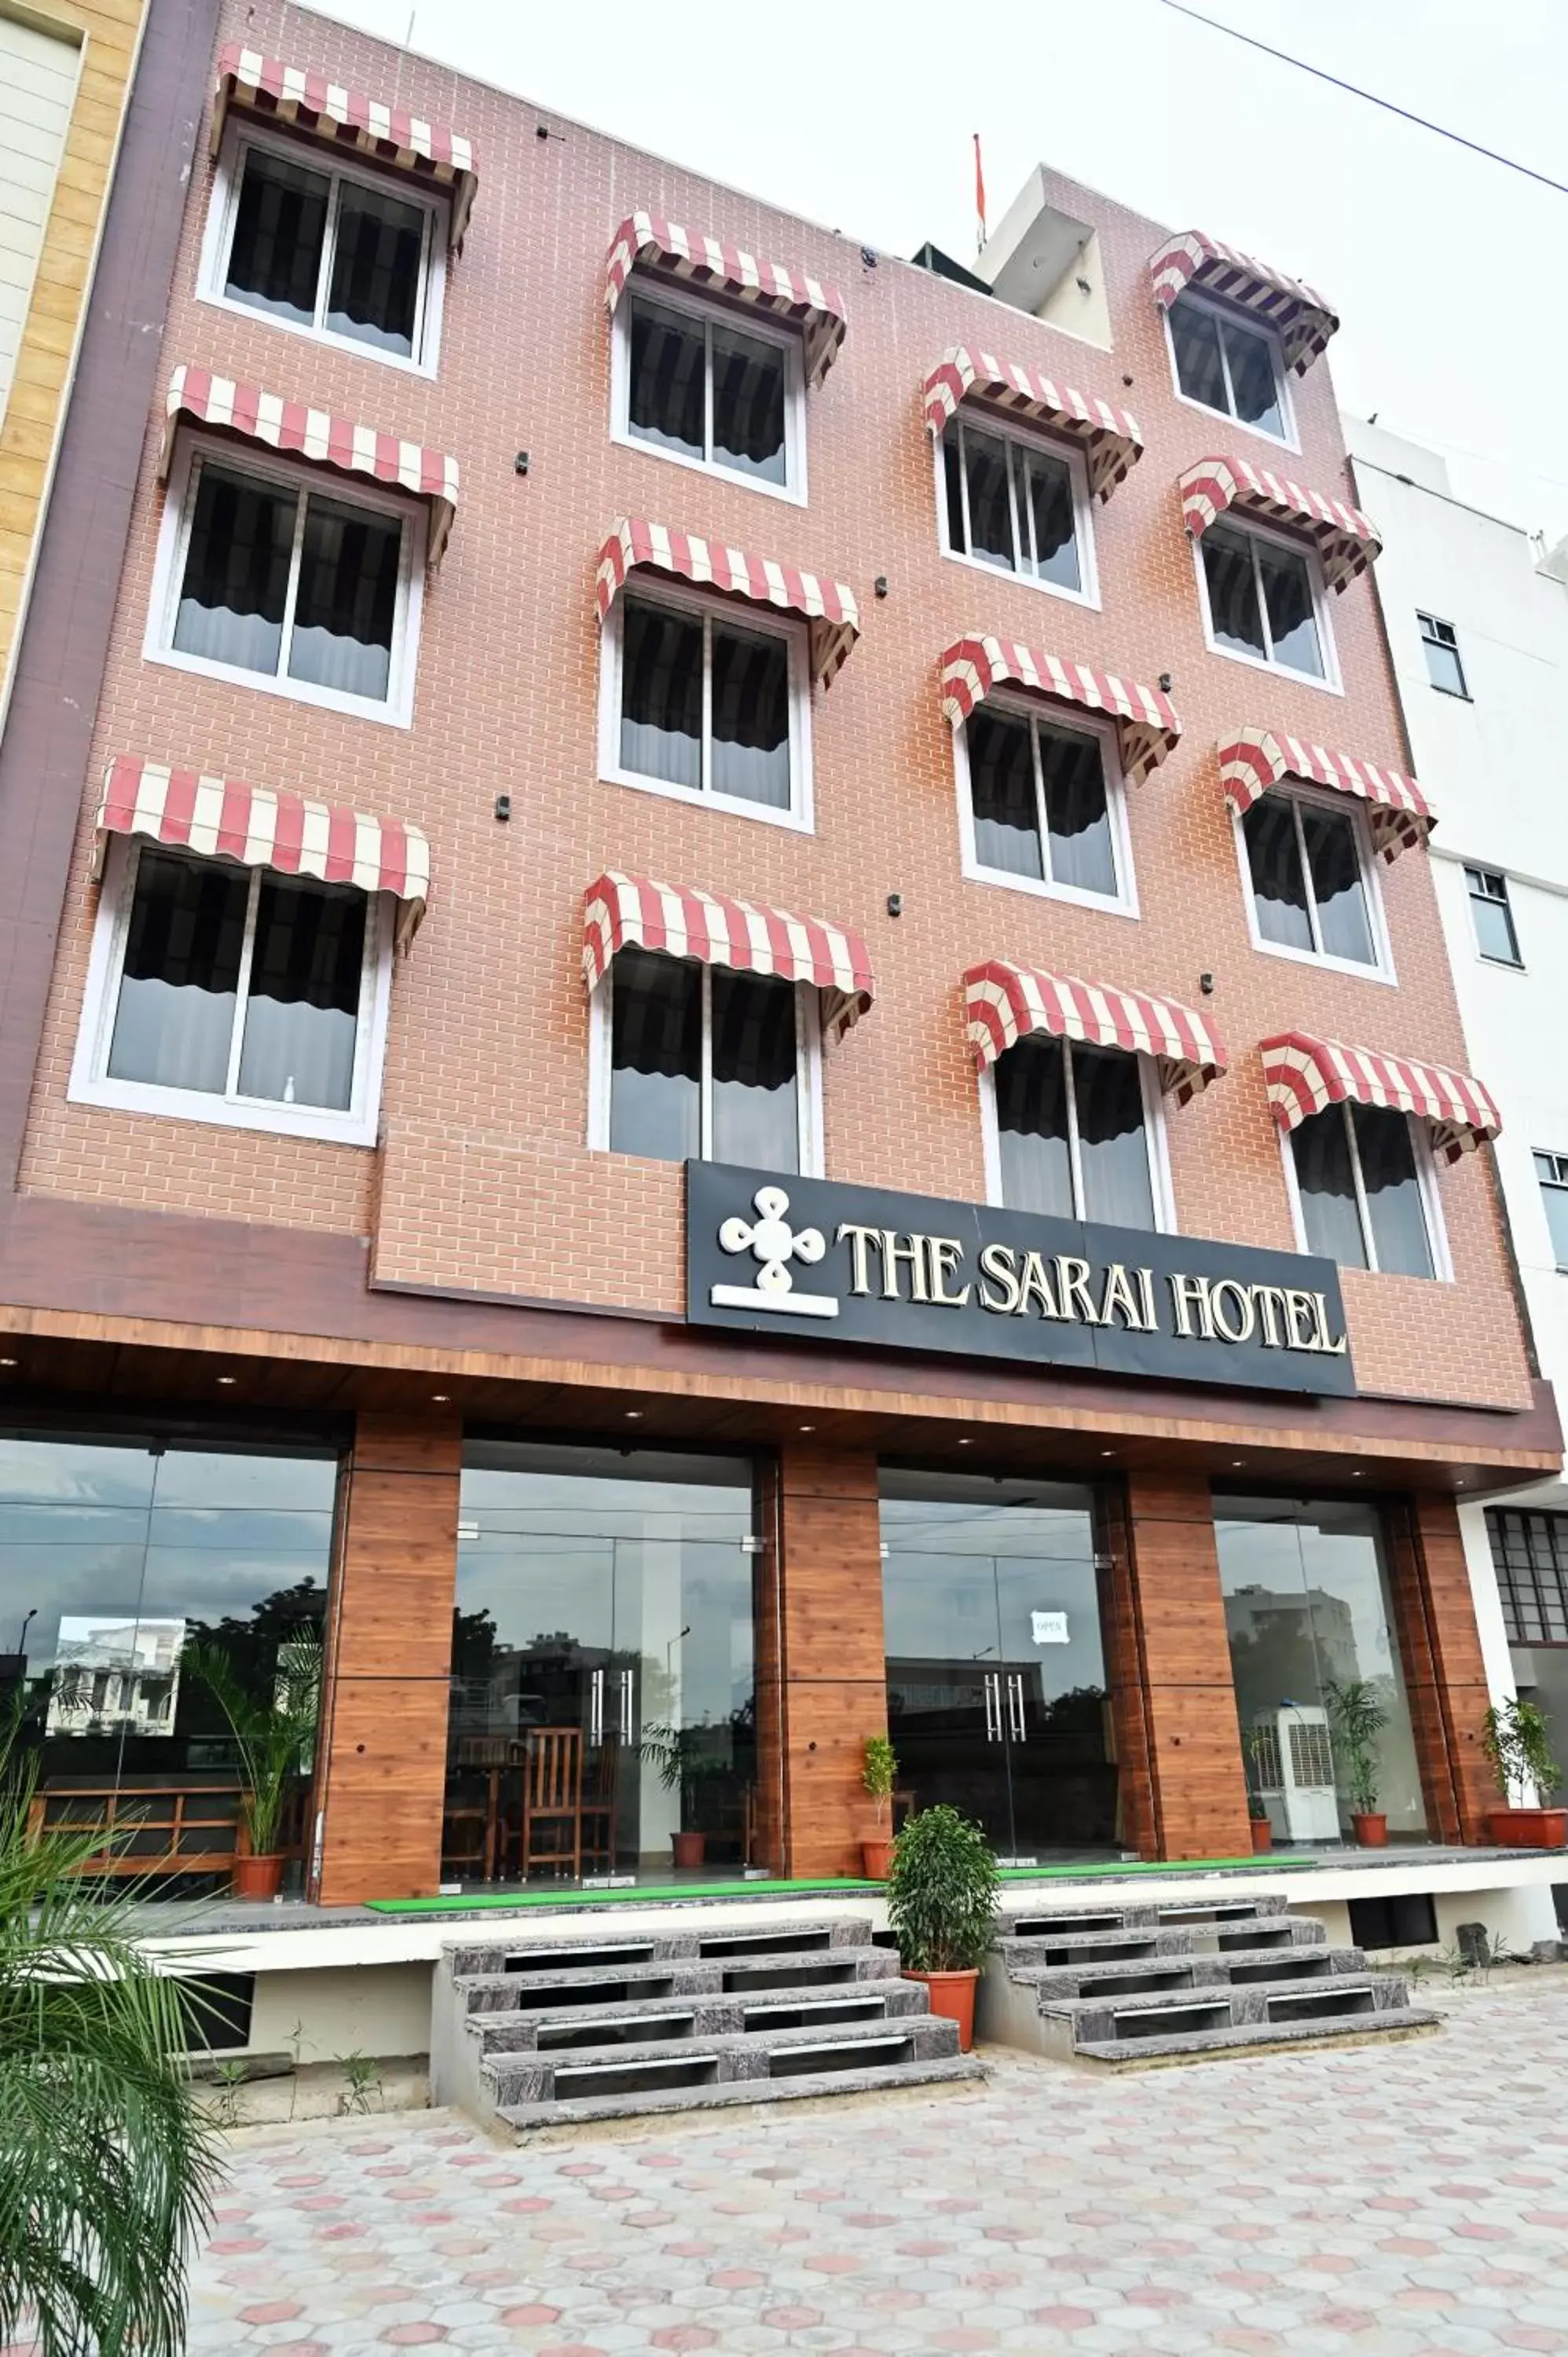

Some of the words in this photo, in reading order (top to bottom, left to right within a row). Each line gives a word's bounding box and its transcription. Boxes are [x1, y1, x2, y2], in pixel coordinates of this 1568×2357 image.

[836, 1222, 971, 1306] THE
[980, 1244, 1160, 1331] SARAI
[1169, 1273, 1347, 1354] HOTEL
